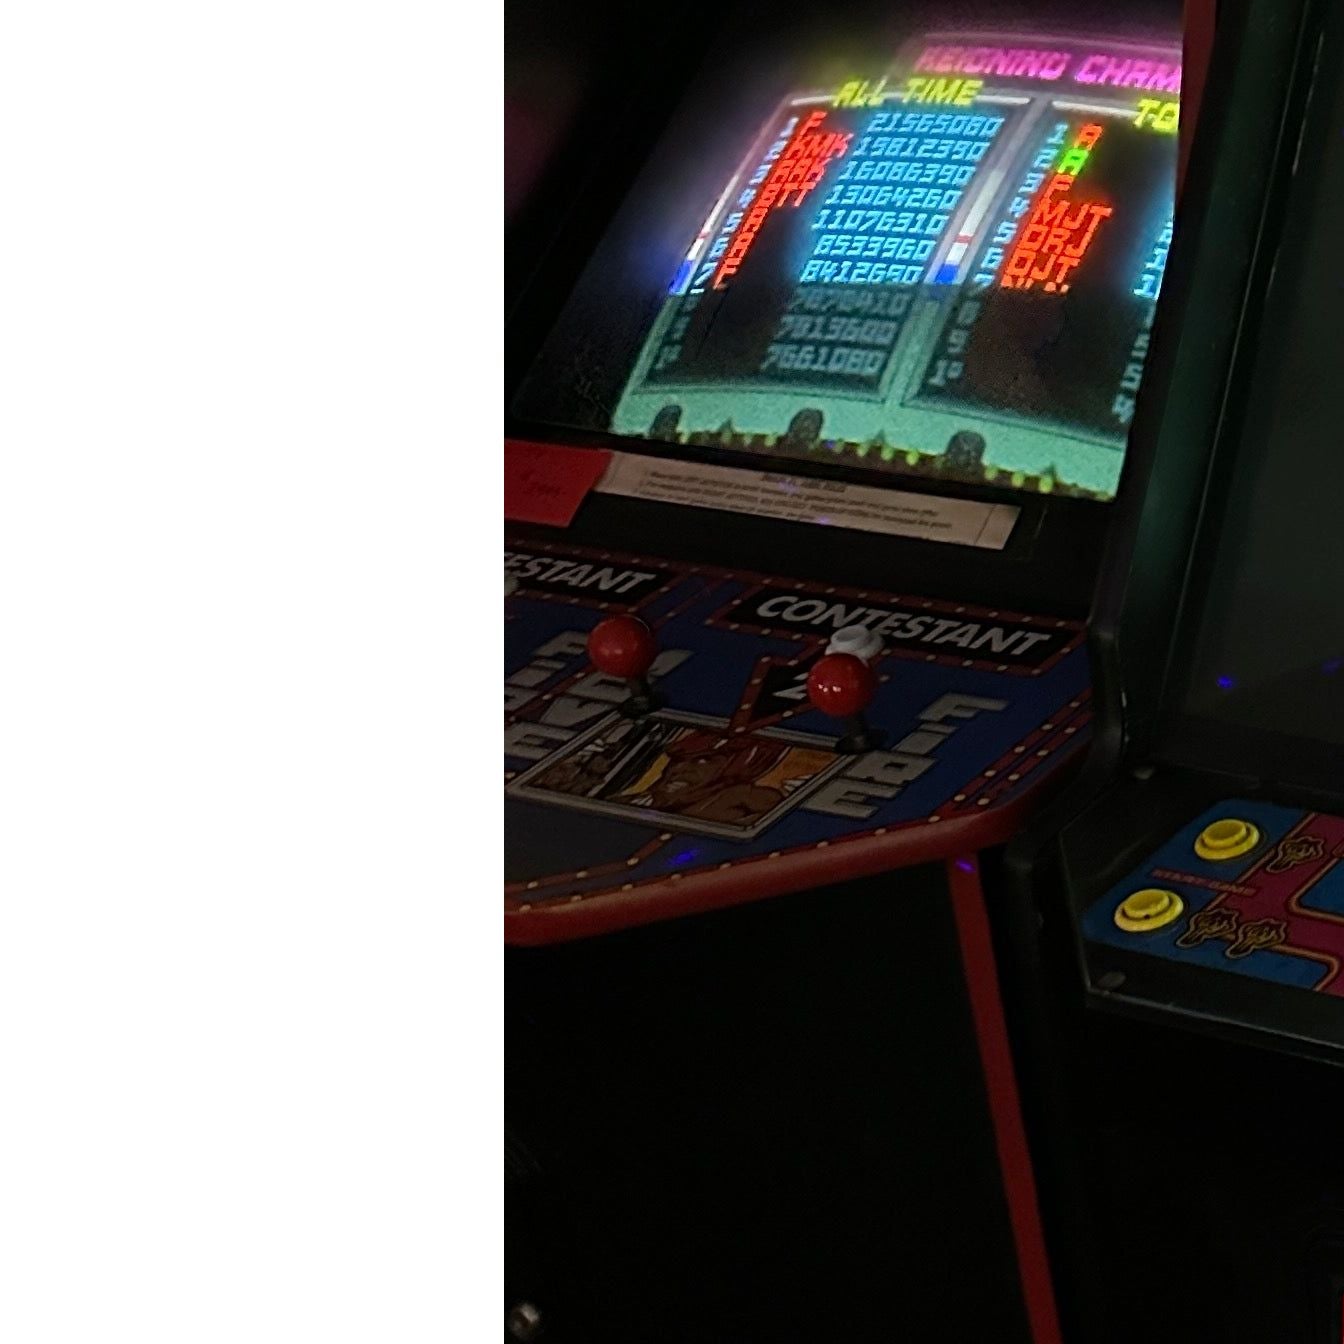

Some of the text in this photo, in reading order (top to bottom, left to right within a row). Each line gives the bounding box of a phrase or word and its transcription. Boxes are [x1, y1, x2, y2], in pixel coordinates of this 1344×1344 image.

[833, 75, 984, 107] ALL TIME
[505, 552, 657, 594] ESTANT
[754, 595, 1052, 656] CONTESTANT
